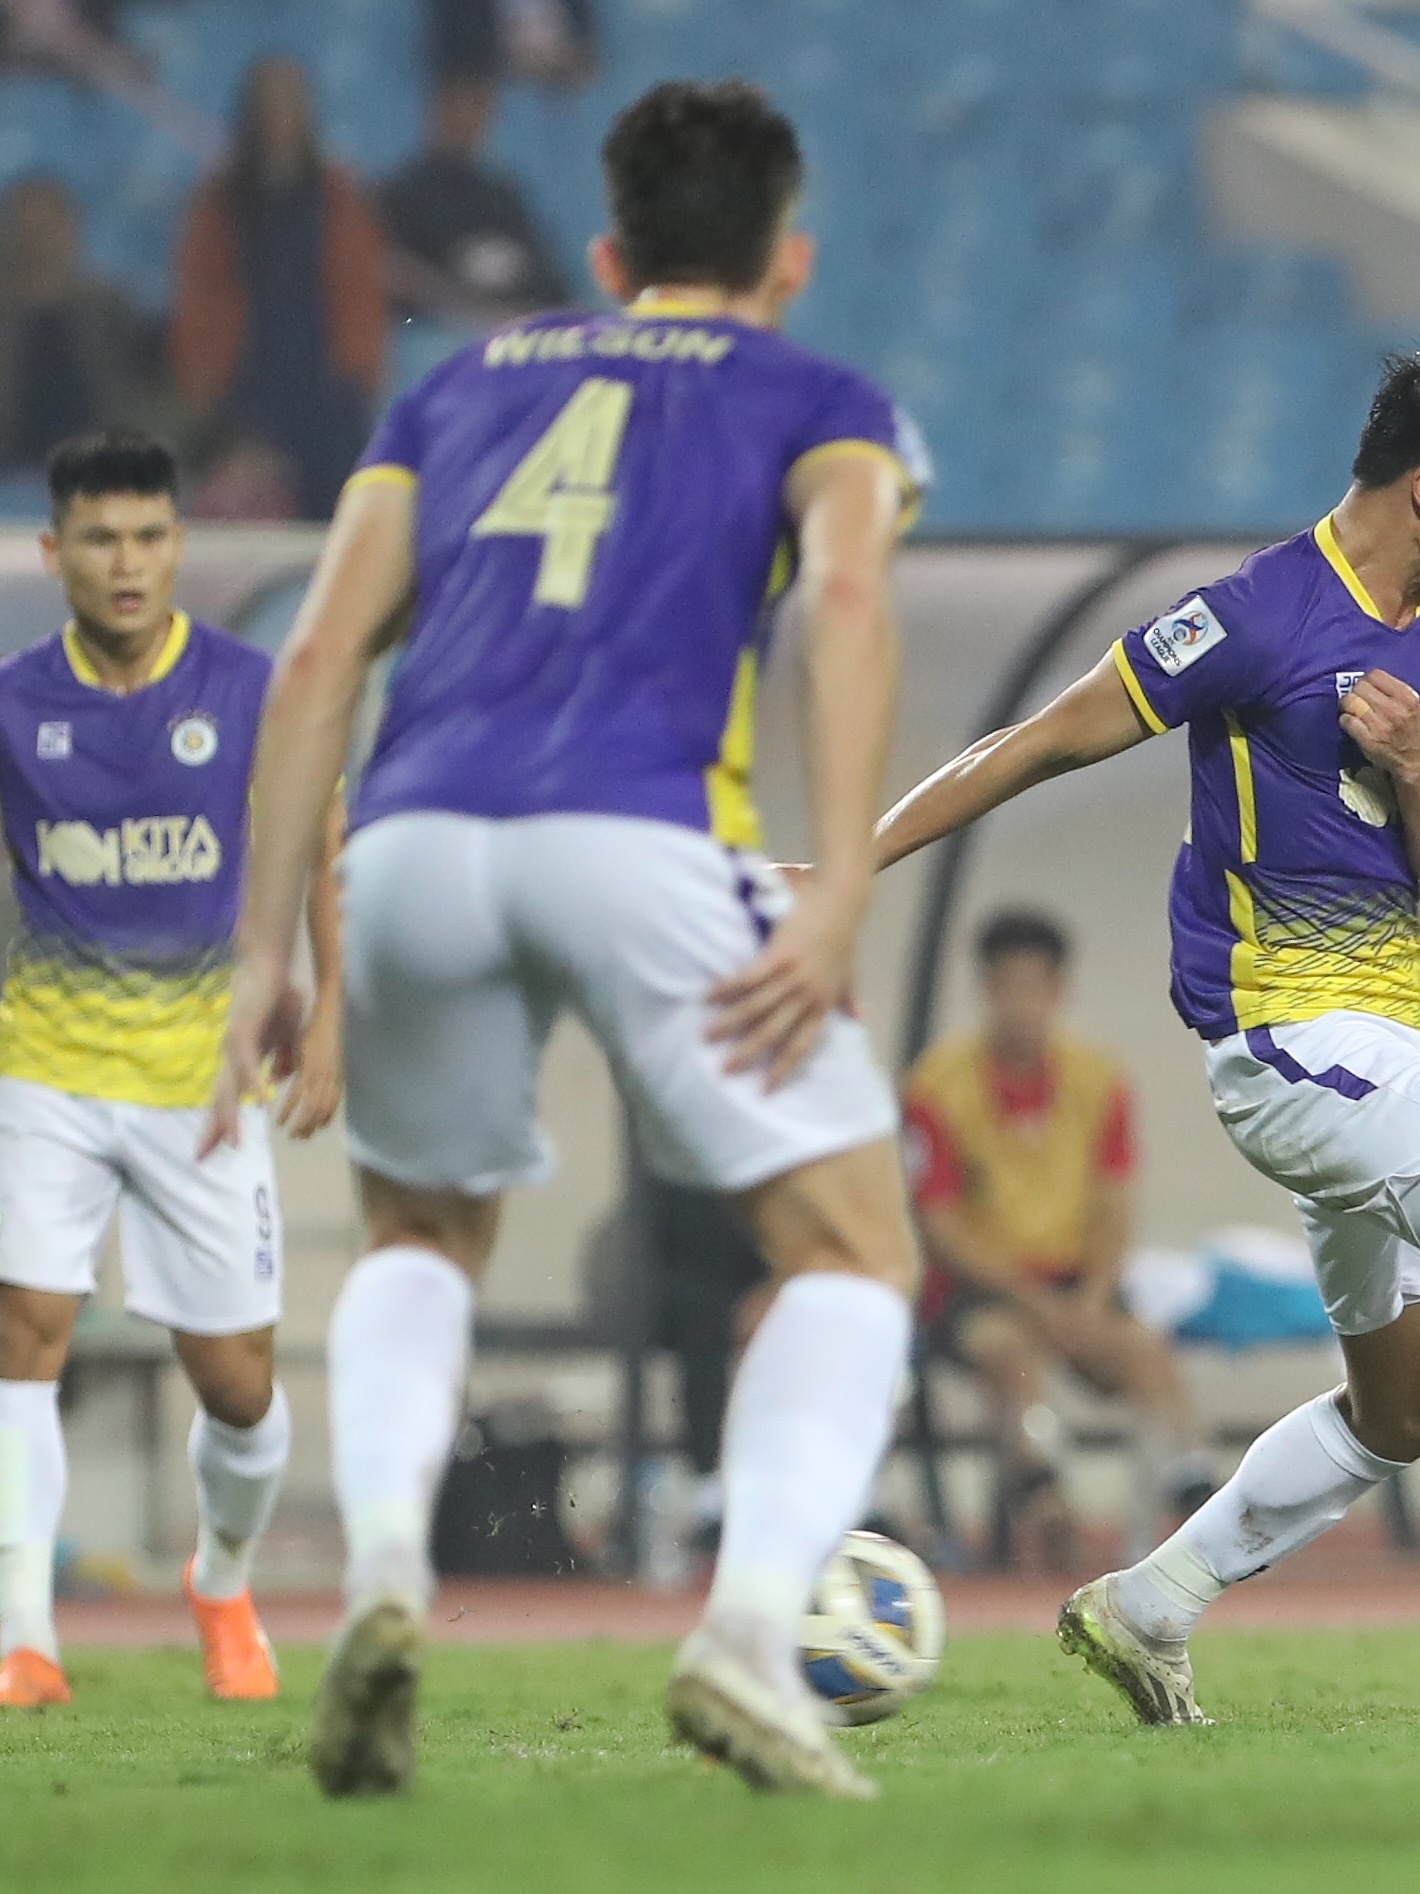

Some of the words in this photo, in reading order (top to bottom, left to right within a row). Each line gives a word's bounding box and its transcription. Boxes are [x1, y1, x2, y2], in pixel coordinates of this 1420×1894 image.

[469, 375, 634, 611] 4
[1150, 637, 1172, 663] LEAGUE
[1153, 627, 1182, 667] CHAMPIONS
[122, 814, 217, 855] KITA
